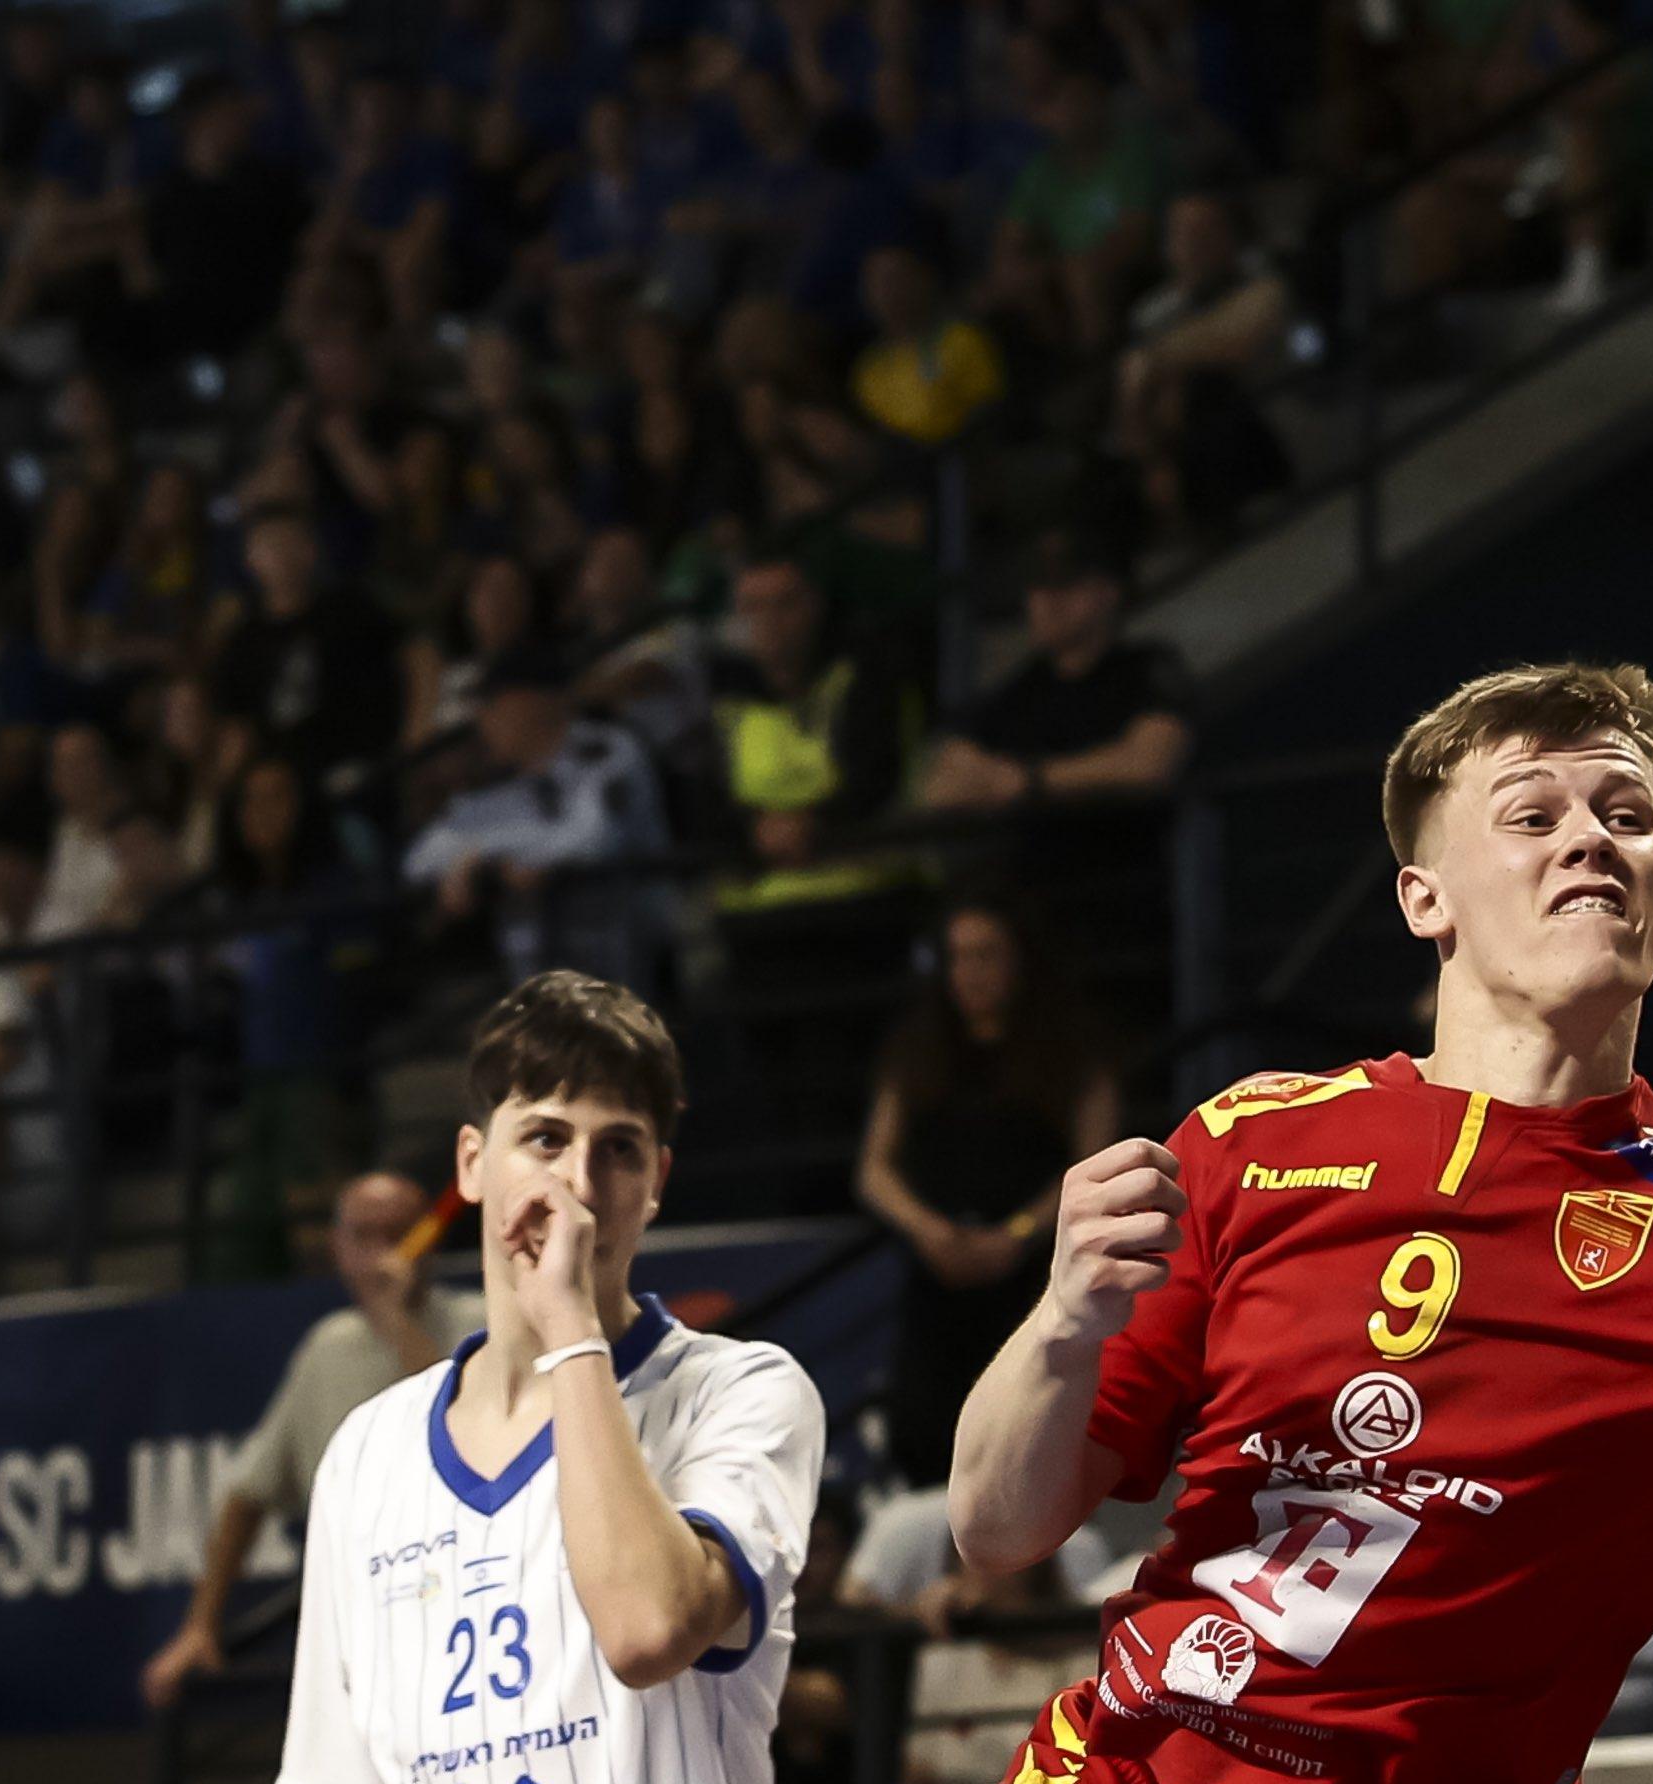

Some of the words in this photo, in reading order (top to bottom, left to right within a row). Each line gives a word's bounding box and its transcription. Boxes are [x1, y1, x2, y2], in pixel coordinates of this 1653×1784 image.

[1241, 1161, 1379, 1191] hummel
[1367, 1230, 1462, 1362] 9
[1239, 1432, 1504, 1515] ALKALOID
[442, 1603, 532, 1715] 23
[1253, 1742, 1325, 1777] спорт
